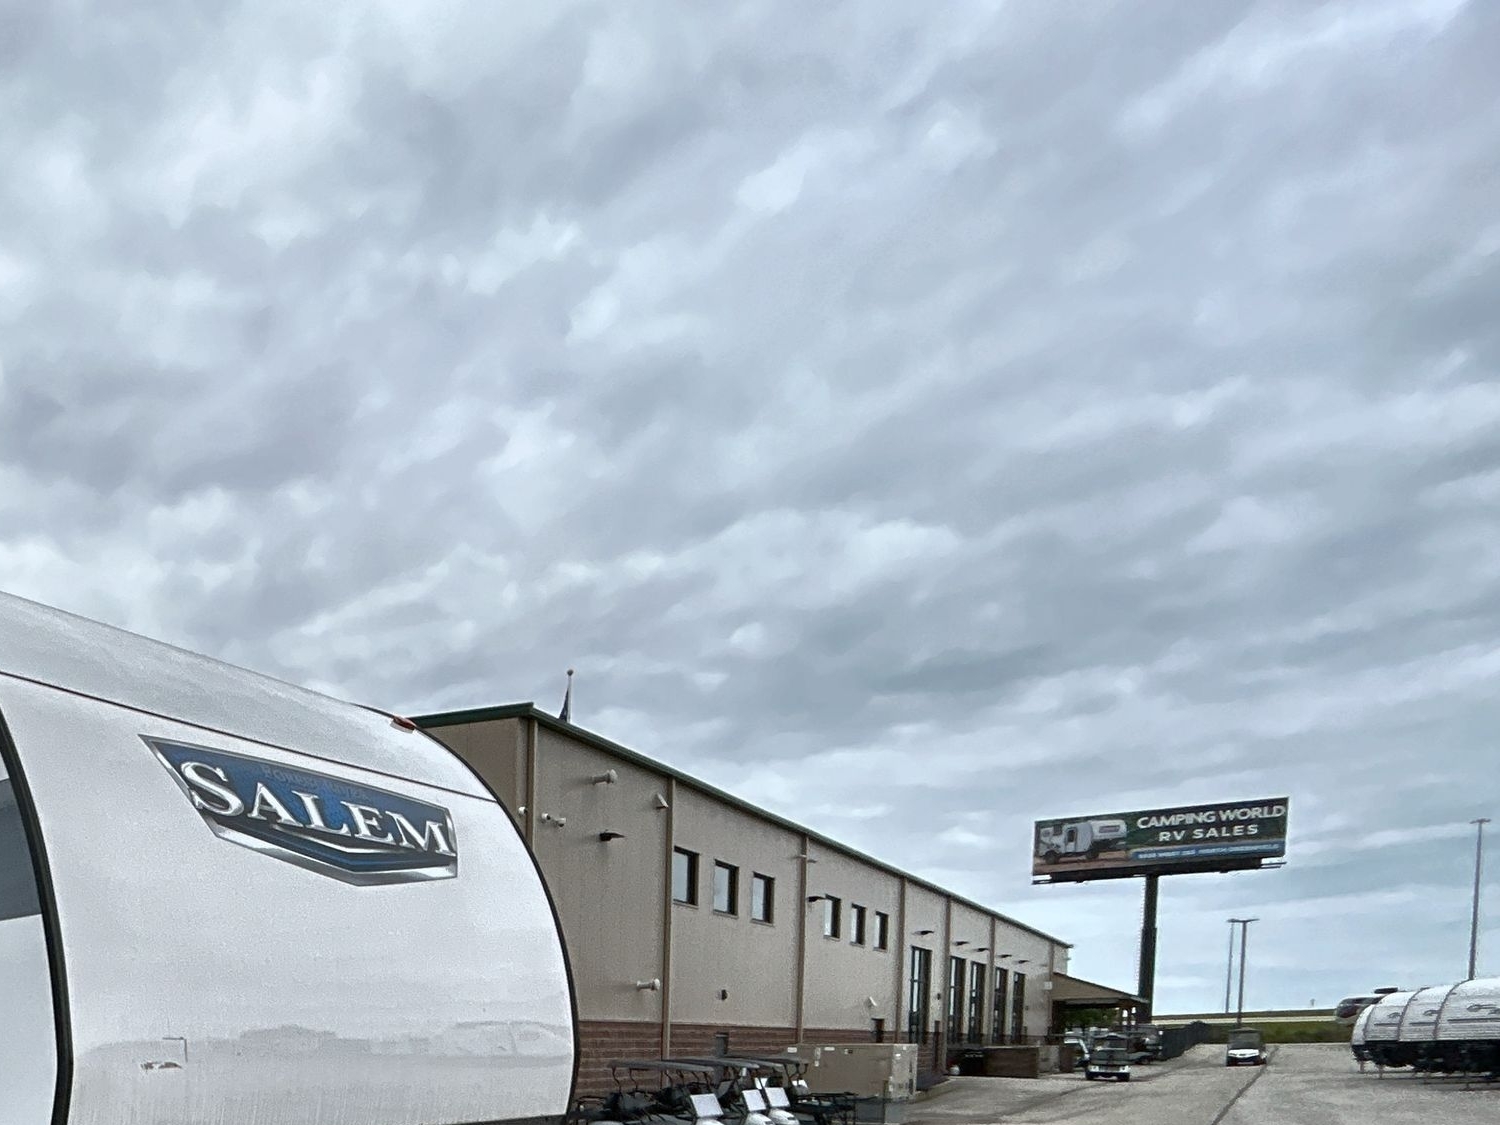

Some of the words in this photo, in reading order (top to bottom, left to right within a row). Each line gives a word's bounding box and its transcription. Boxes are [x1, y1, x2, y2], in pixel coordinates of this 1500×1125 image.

[181, 760, 458, 857] SALEM
[1136, 810, 1217, 829] CAMPING
[1218, 804, 1287, 822] WORLD
[1158, 830, 1186, 842] RV
[1192, 824, 1259, 839] SALES
